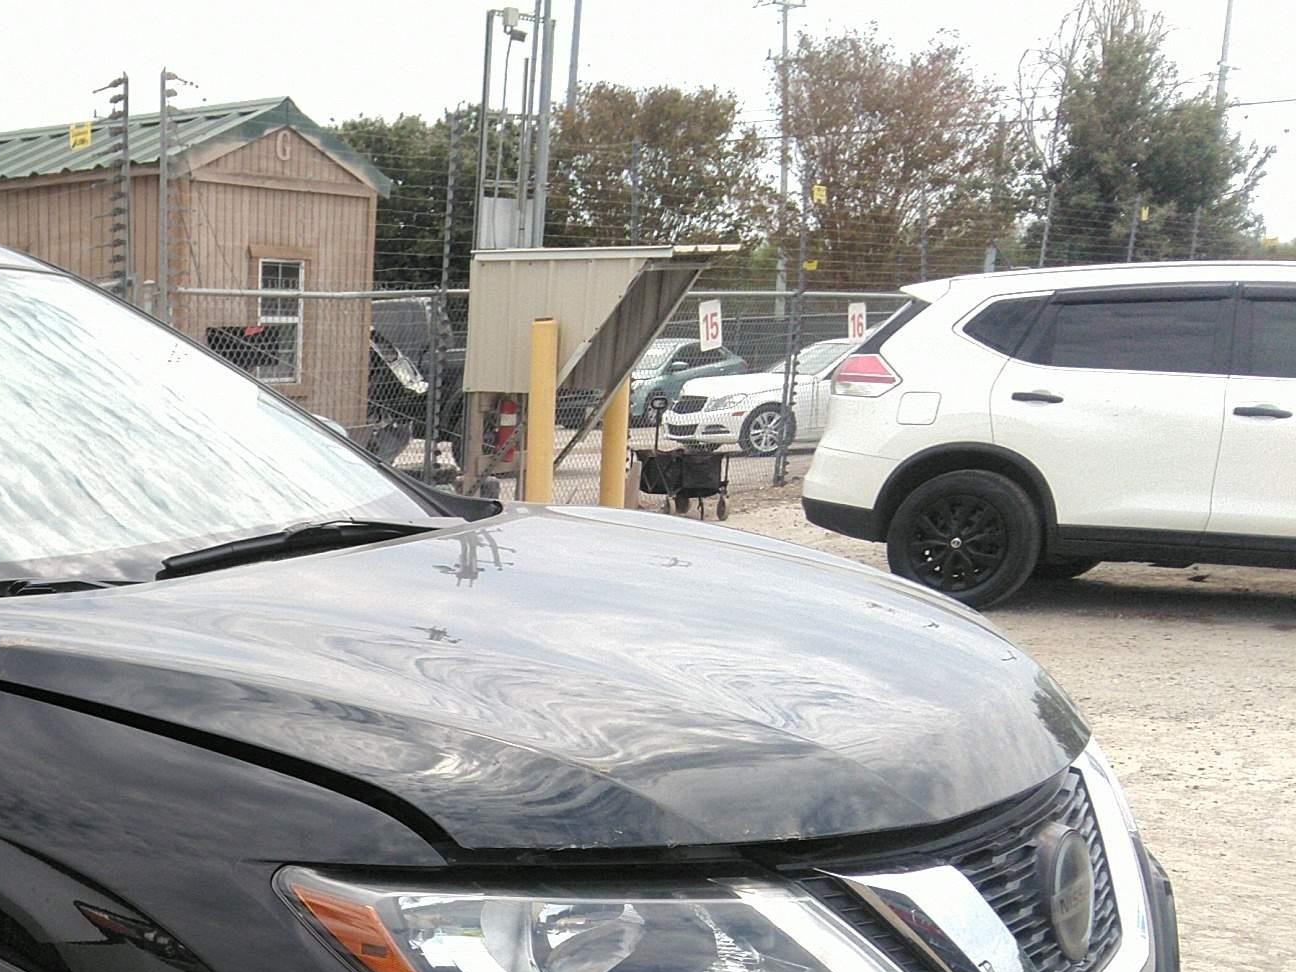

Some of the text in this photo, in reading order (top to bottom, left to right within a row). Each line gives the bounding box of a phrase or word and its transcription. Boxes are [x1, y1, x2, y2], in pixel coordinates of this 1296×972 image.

[276, 130, 291, 160] G
[703, 312, 719, 341] 15
[850, 313, 864, 338] 16
